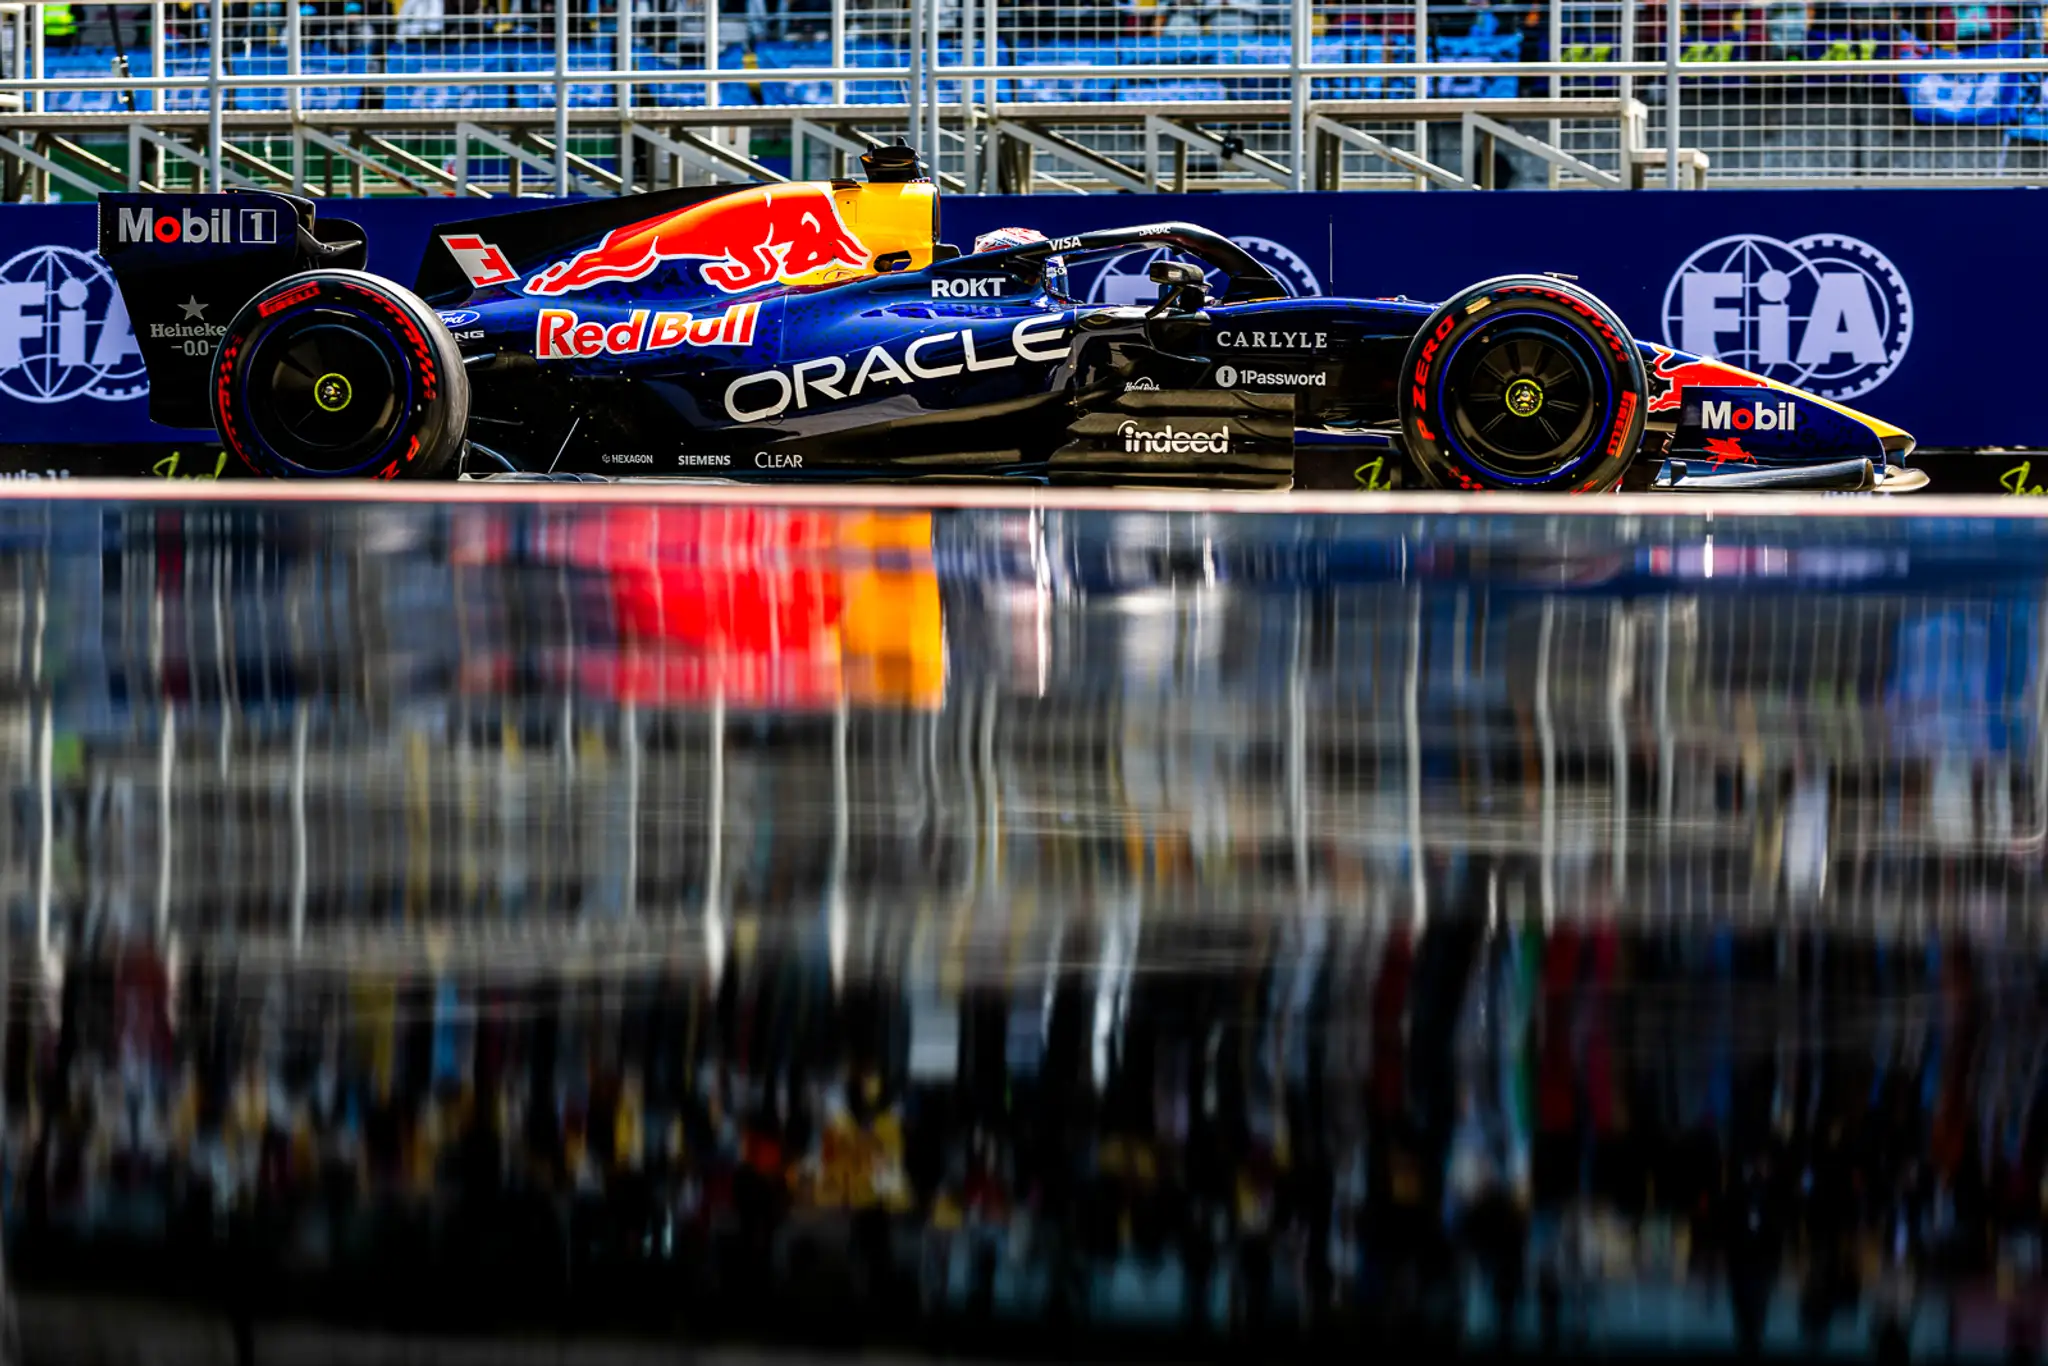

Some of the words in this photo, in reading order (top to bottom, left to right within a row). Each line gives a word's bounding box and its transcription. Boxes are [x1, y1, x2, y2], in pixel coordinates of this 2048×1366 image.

[119, 207, 231, 244] Mobil
[1046, 236, 1082, 251] VISA
[931, 277, 1006, 298] ROKT
[536, 308, 651, 360] Red
[645, 301, 762, 350] Bull
[1216, 331, 1328, 349] CARLYLE
[183, 339, 209, 356] 0.0
[724, 312, 1072, 423] ORACLE
[1412, 314, 1456, 413] ZERO
[1240, 369, 1326, 386] 1Password
[1701, 399, 1796, 432] Mobil
[1117, 420, 1230, 454] indeed
[611, 454, 654, 464] HEXAGON
[678, 454, 731, 466] SIEMENS
[754, 451, 803, 469] CLEAR
